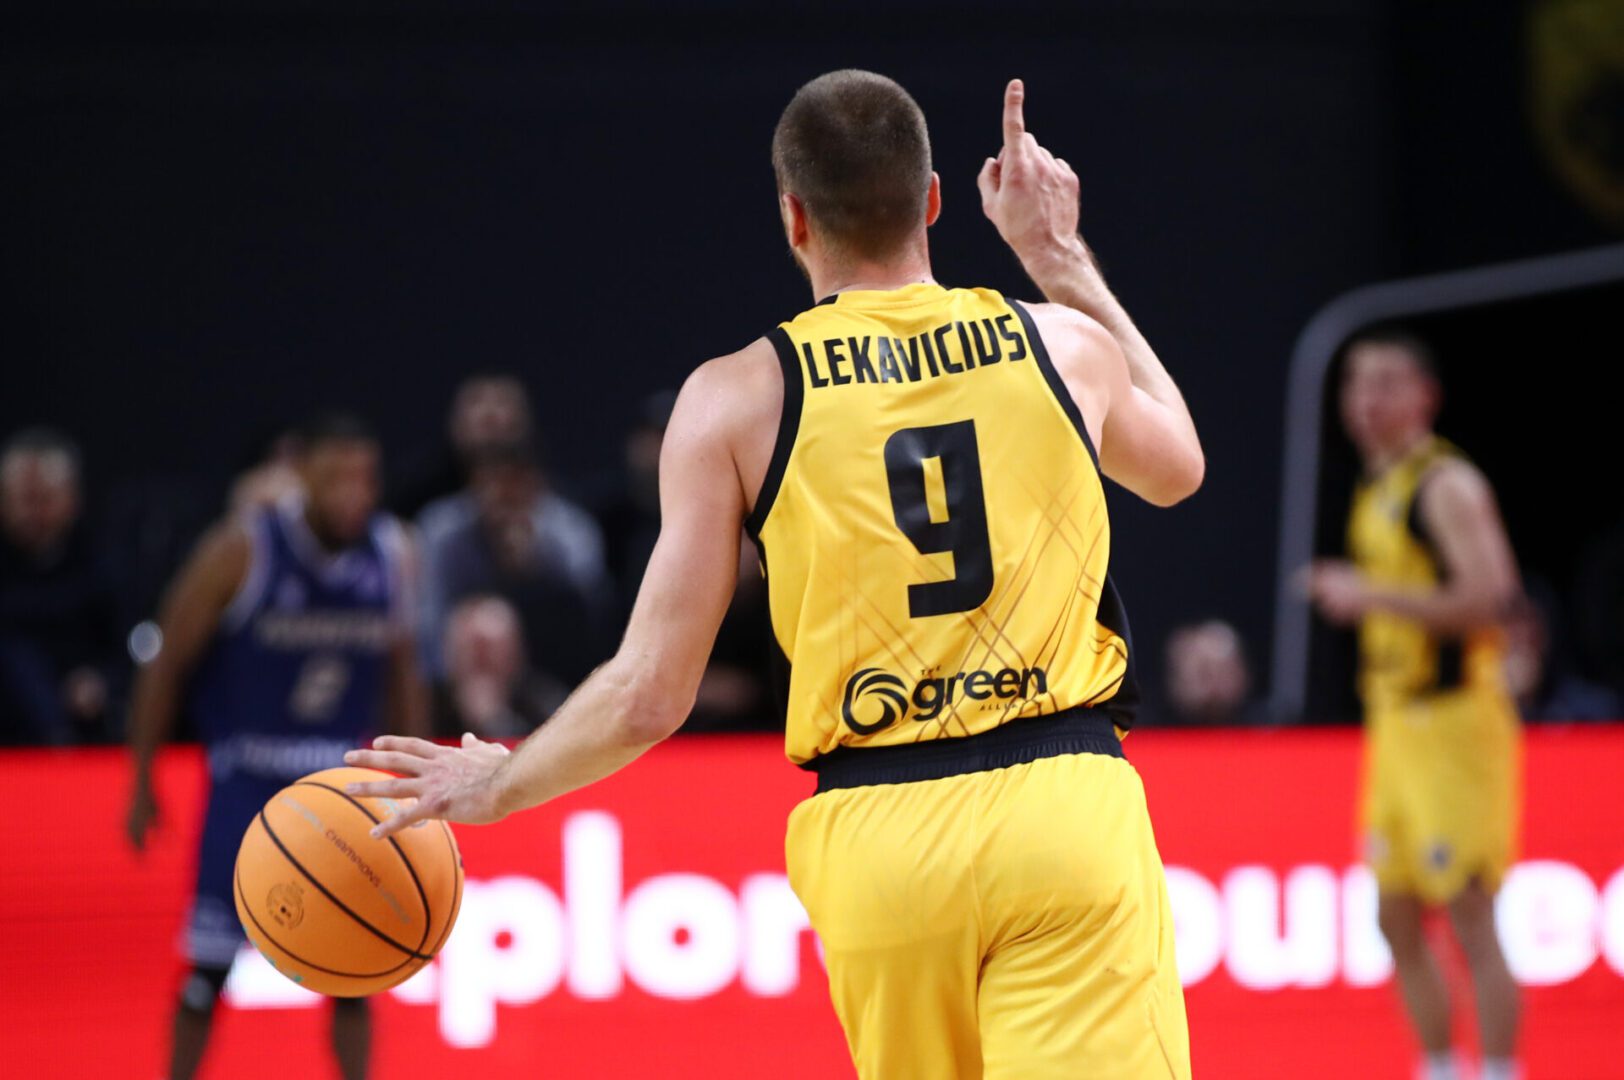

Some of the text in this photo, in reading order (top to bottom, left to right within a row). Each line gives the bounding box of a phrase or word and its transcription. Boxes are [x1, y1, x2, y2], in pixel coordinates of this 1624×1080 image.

[802, 314, 1027, 388] LEKAVICIUS
[884, 419, 995, 619] 9
[912, 666, 1048, 722] green
